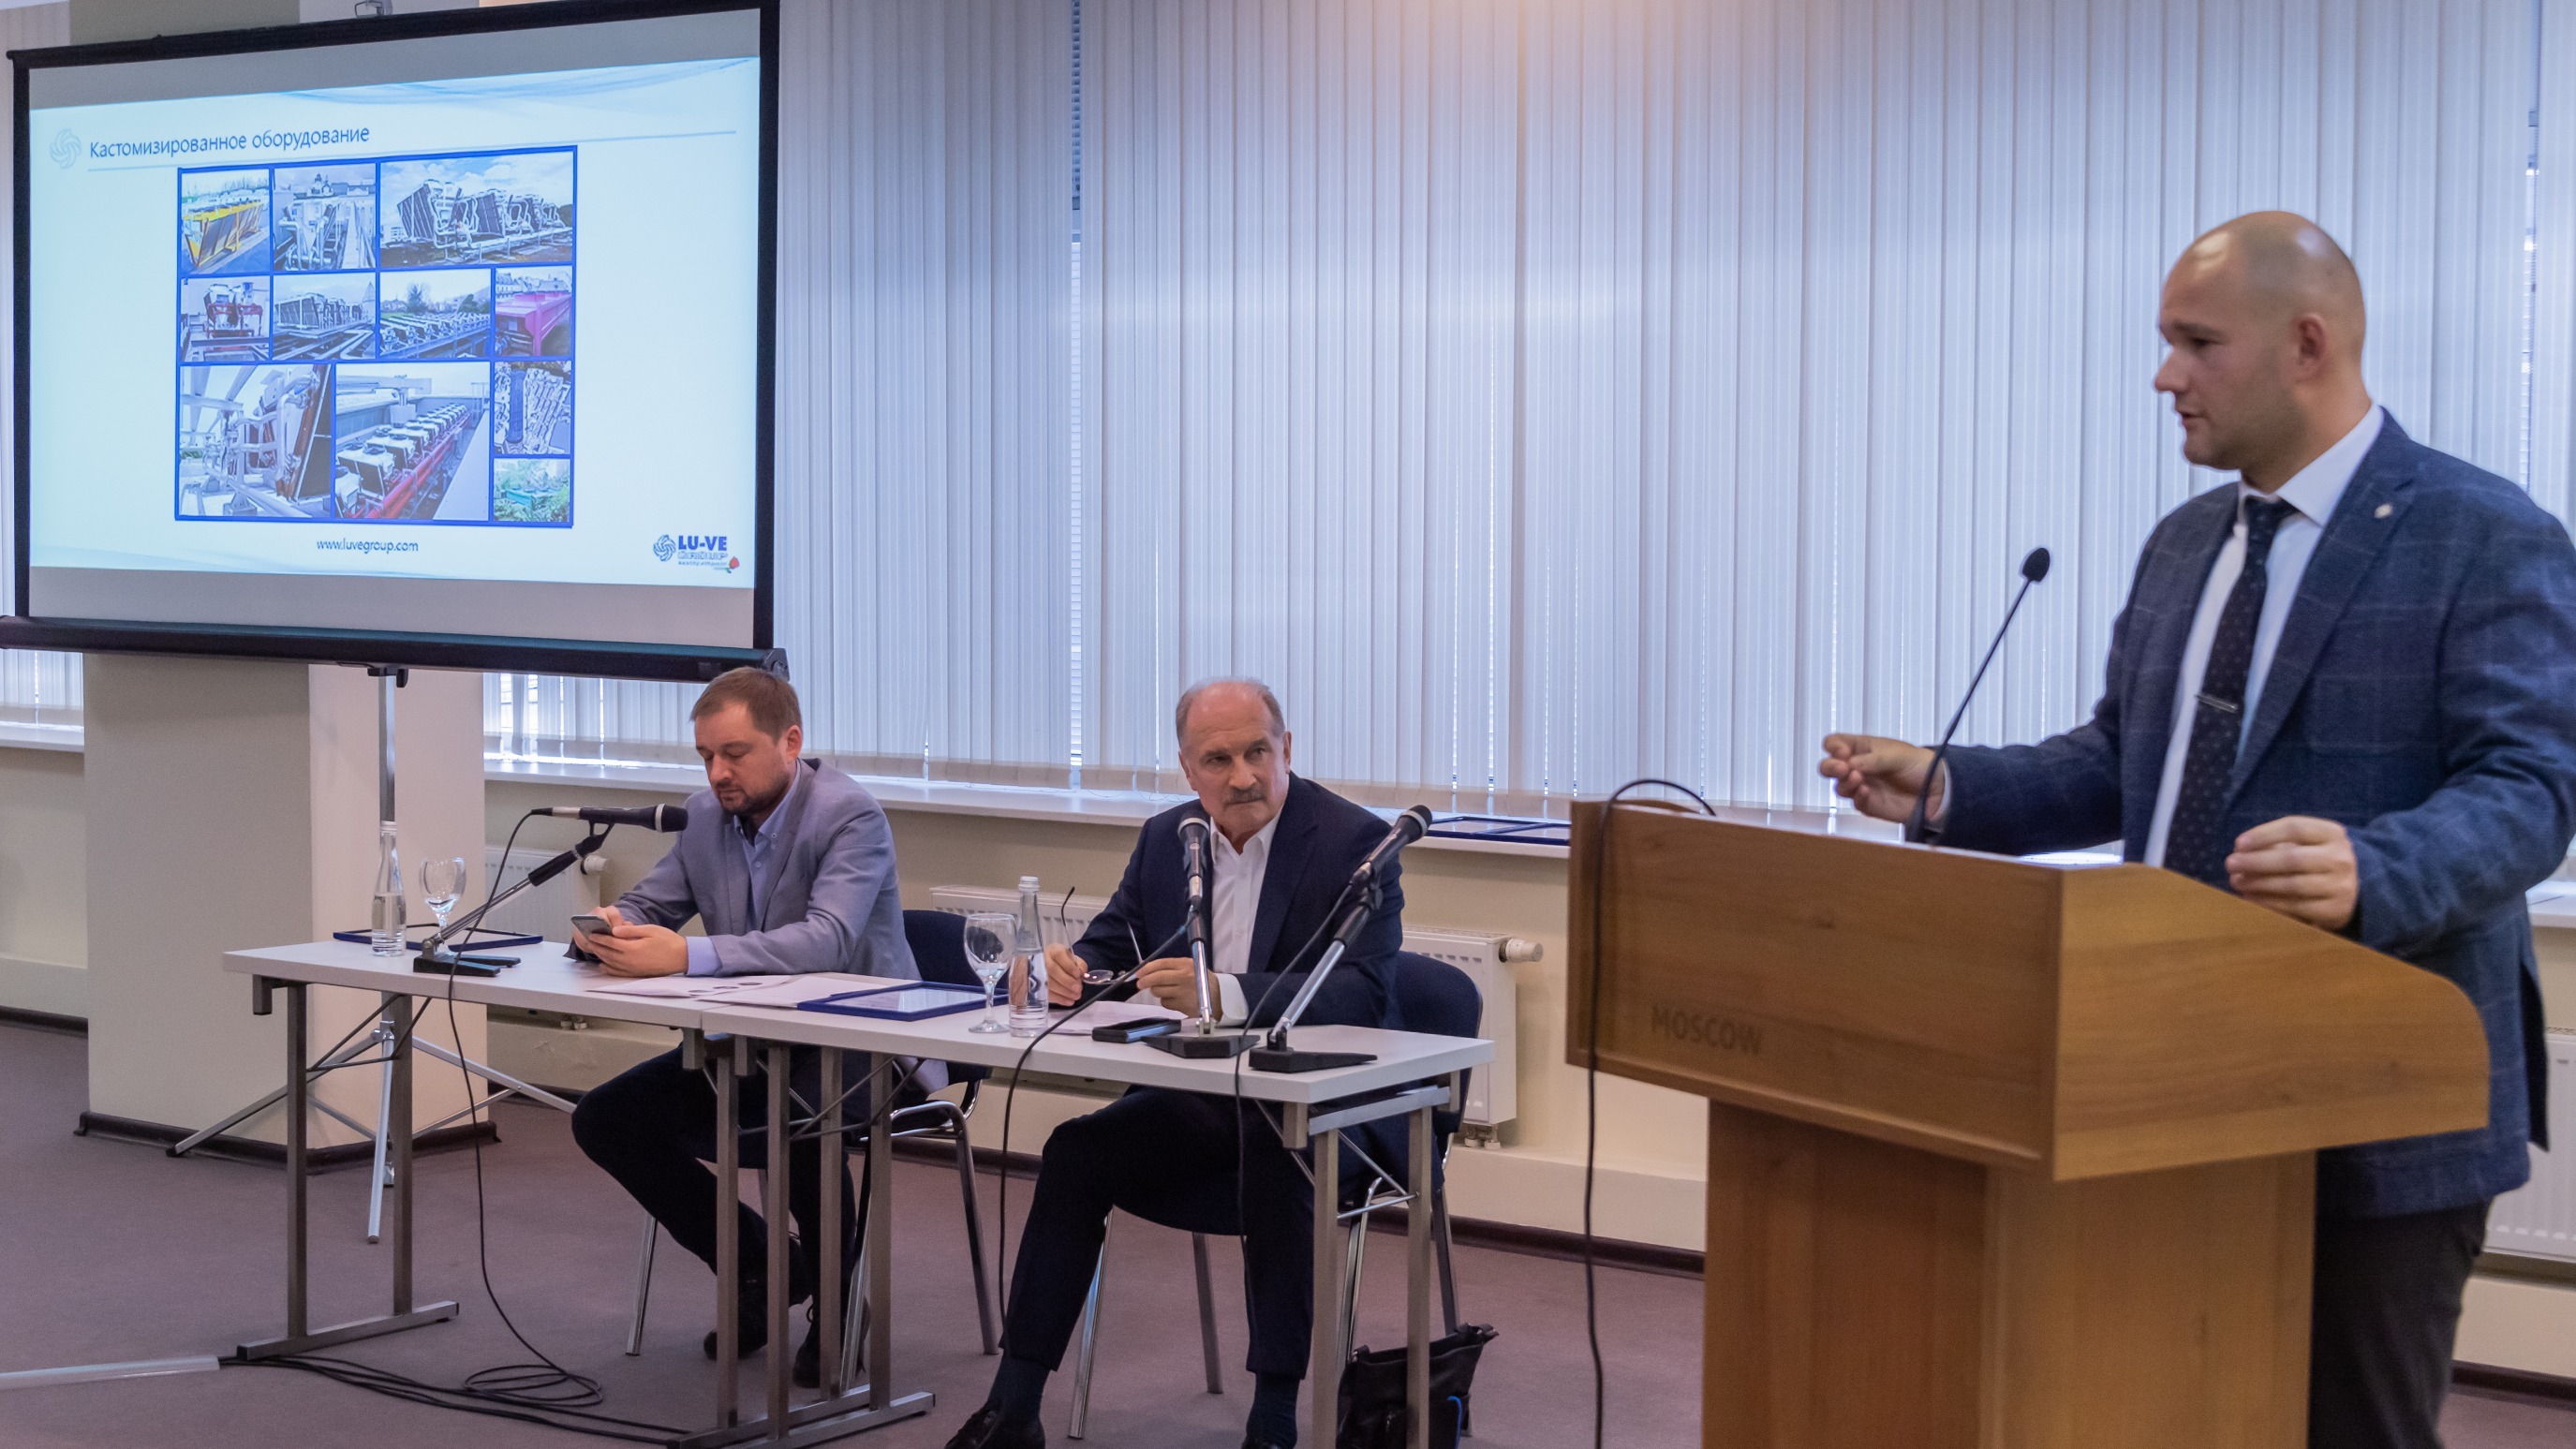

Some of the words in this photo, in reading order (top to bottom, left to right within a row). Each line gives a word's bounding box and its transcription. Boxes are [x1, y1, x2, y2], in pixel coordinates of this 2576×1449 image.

[90, 135, 247, 158] Кастомизированное
[252, 126, 370, 151] оборудование
[317, 538, 419, 554] www.luvegroup.com
[678, 535, 728, 551] LU-VE
[1651, 1005, 1761, 1056] MOSCOW
